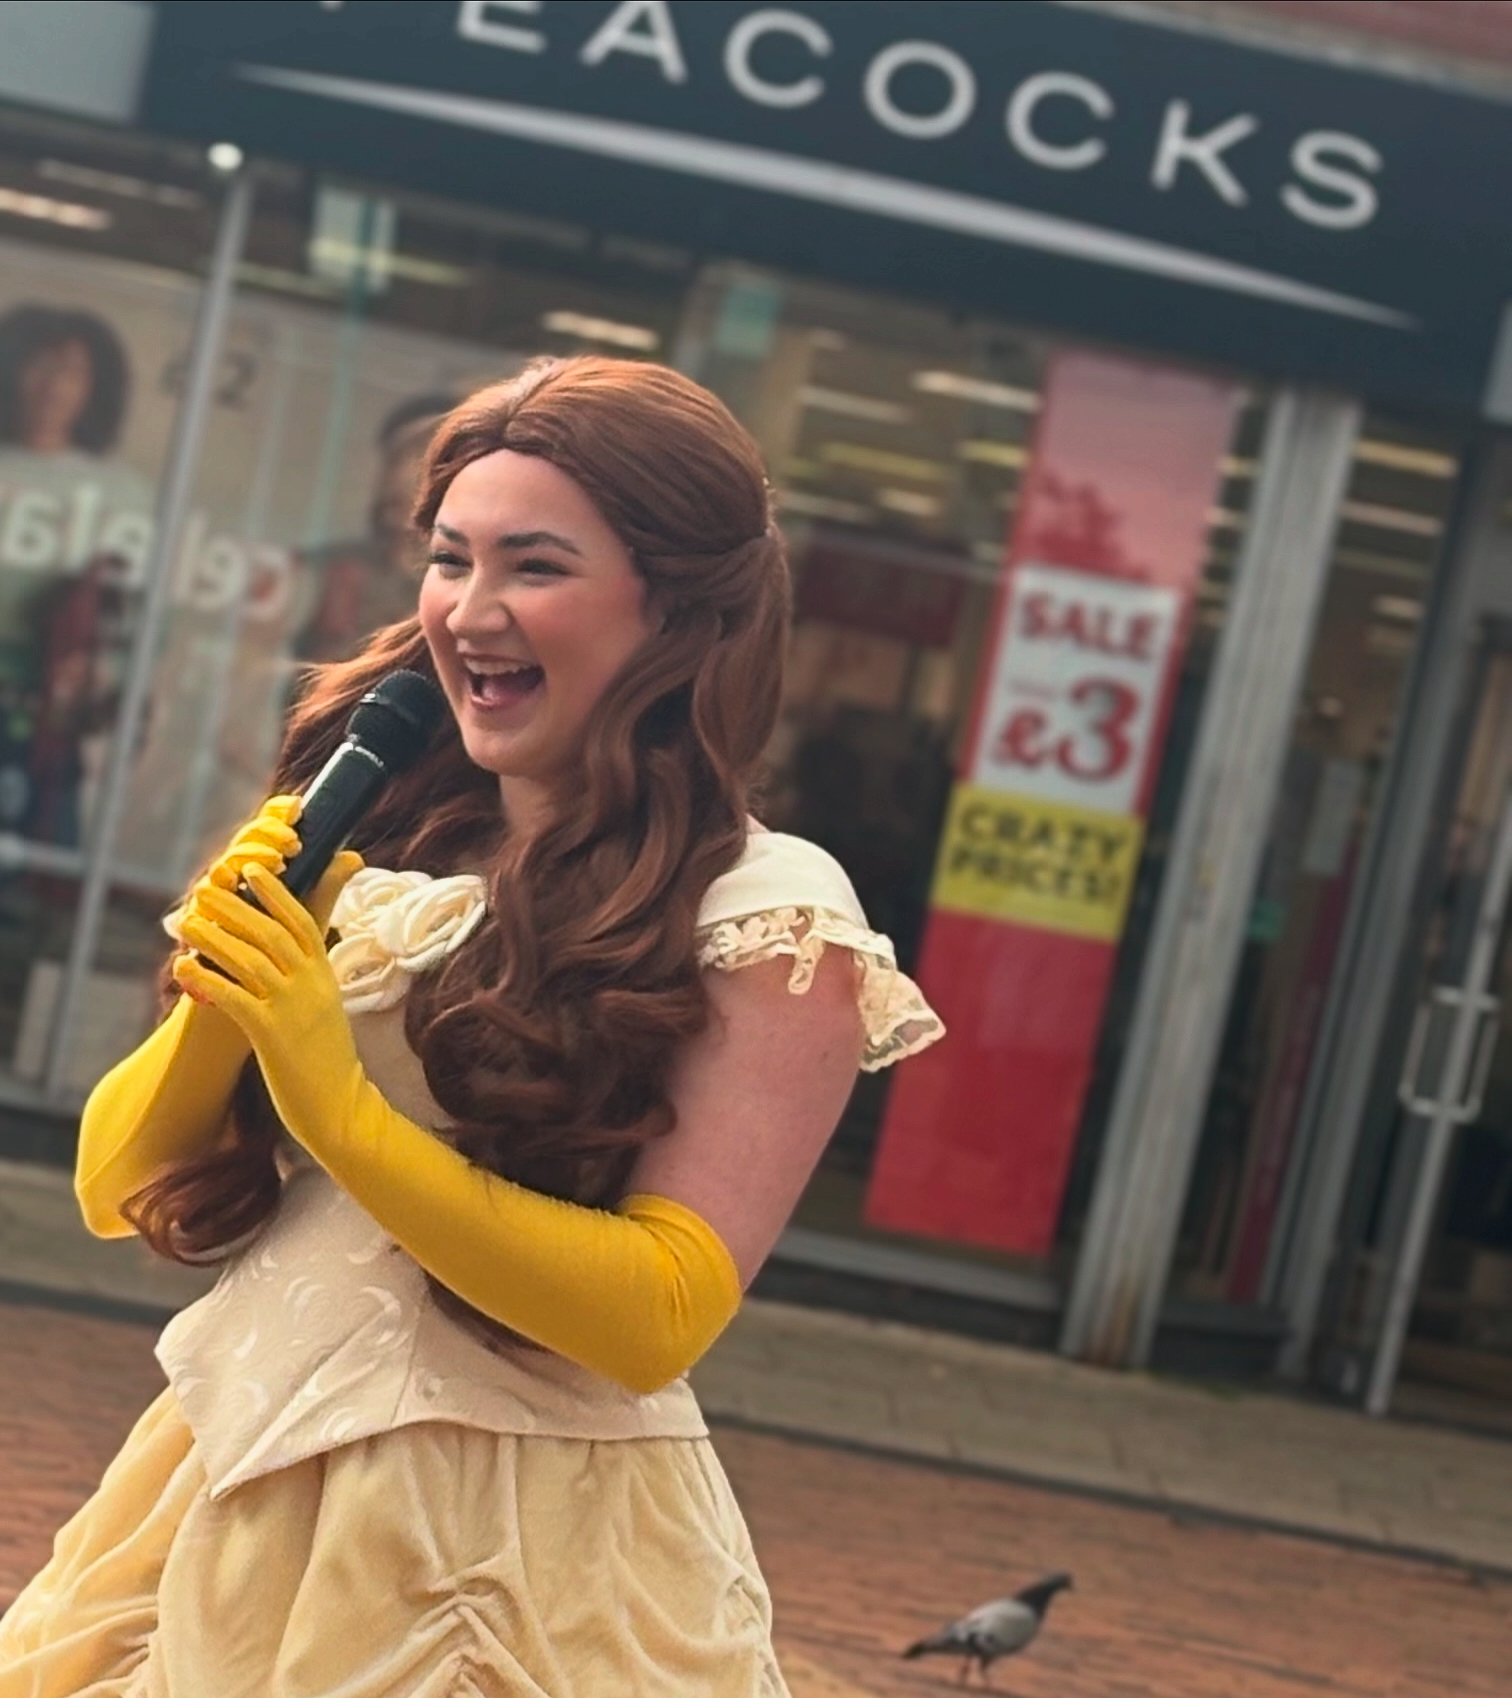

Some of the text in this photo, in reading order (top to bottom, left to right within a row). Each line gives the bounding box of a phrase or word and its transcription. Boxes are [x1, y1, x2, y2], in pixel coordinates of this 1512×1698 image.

[318, 0, 1384, 230] EACOCKS
[1023, 591, 1159, 663] SALE
[992, 675, 1141, 786] £3
[961, 803, 1128, 864] CRAZY
